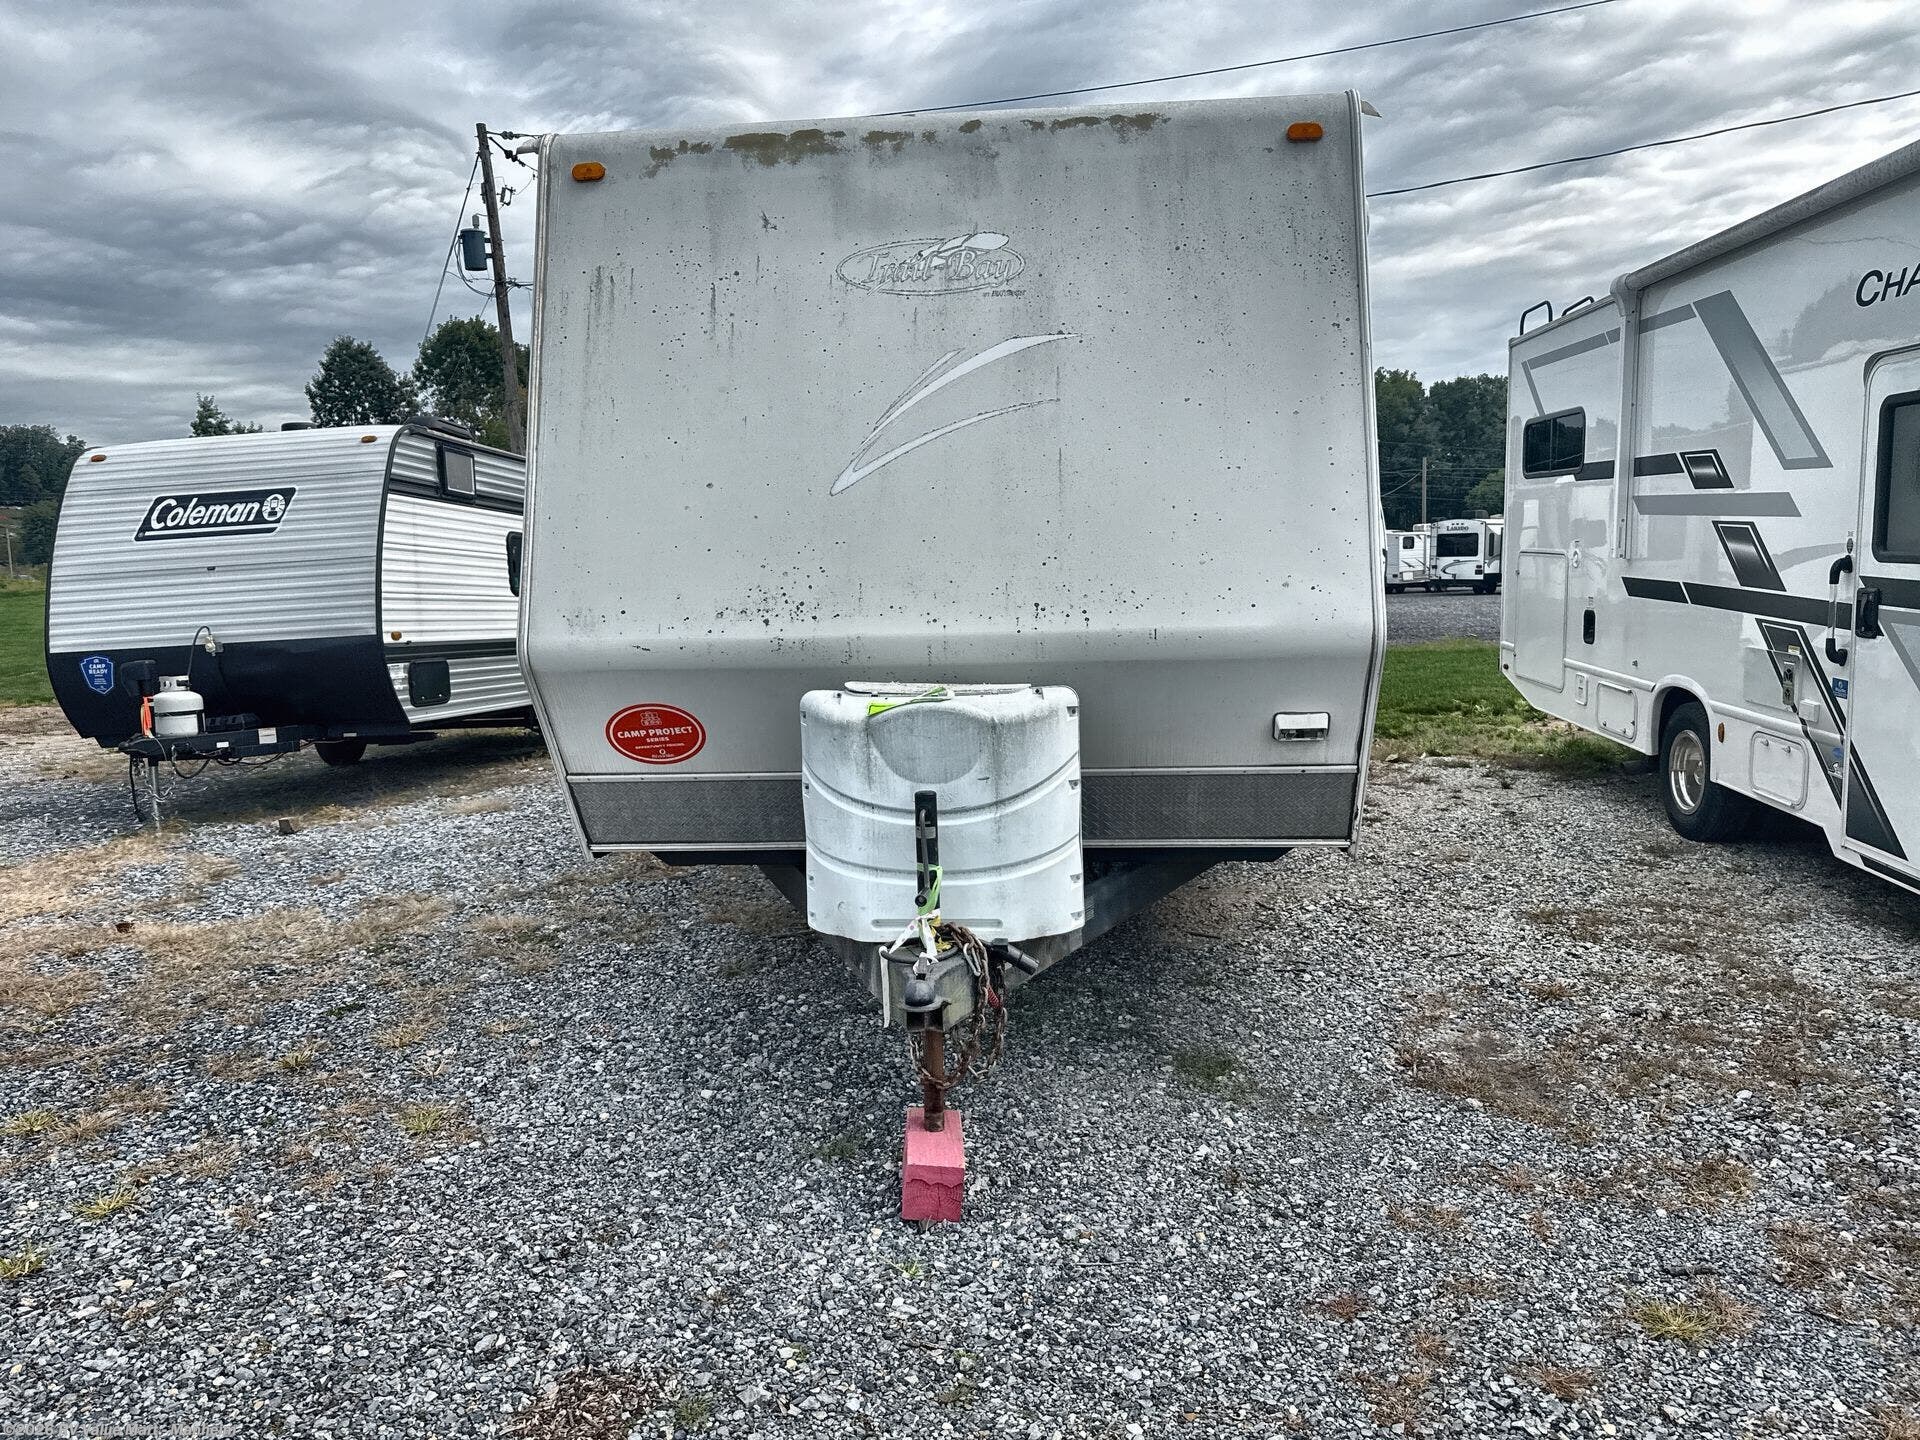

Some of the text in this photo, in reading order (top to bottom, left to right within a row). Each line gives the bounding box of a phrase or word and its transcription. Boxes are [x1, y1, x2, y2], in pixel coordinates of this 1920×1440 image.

[861, 249, 1012, 287] Trail Bay
[150, 497, 261, 530] Coleman
[617, 726, 693, 739] CAMP PROJECT
